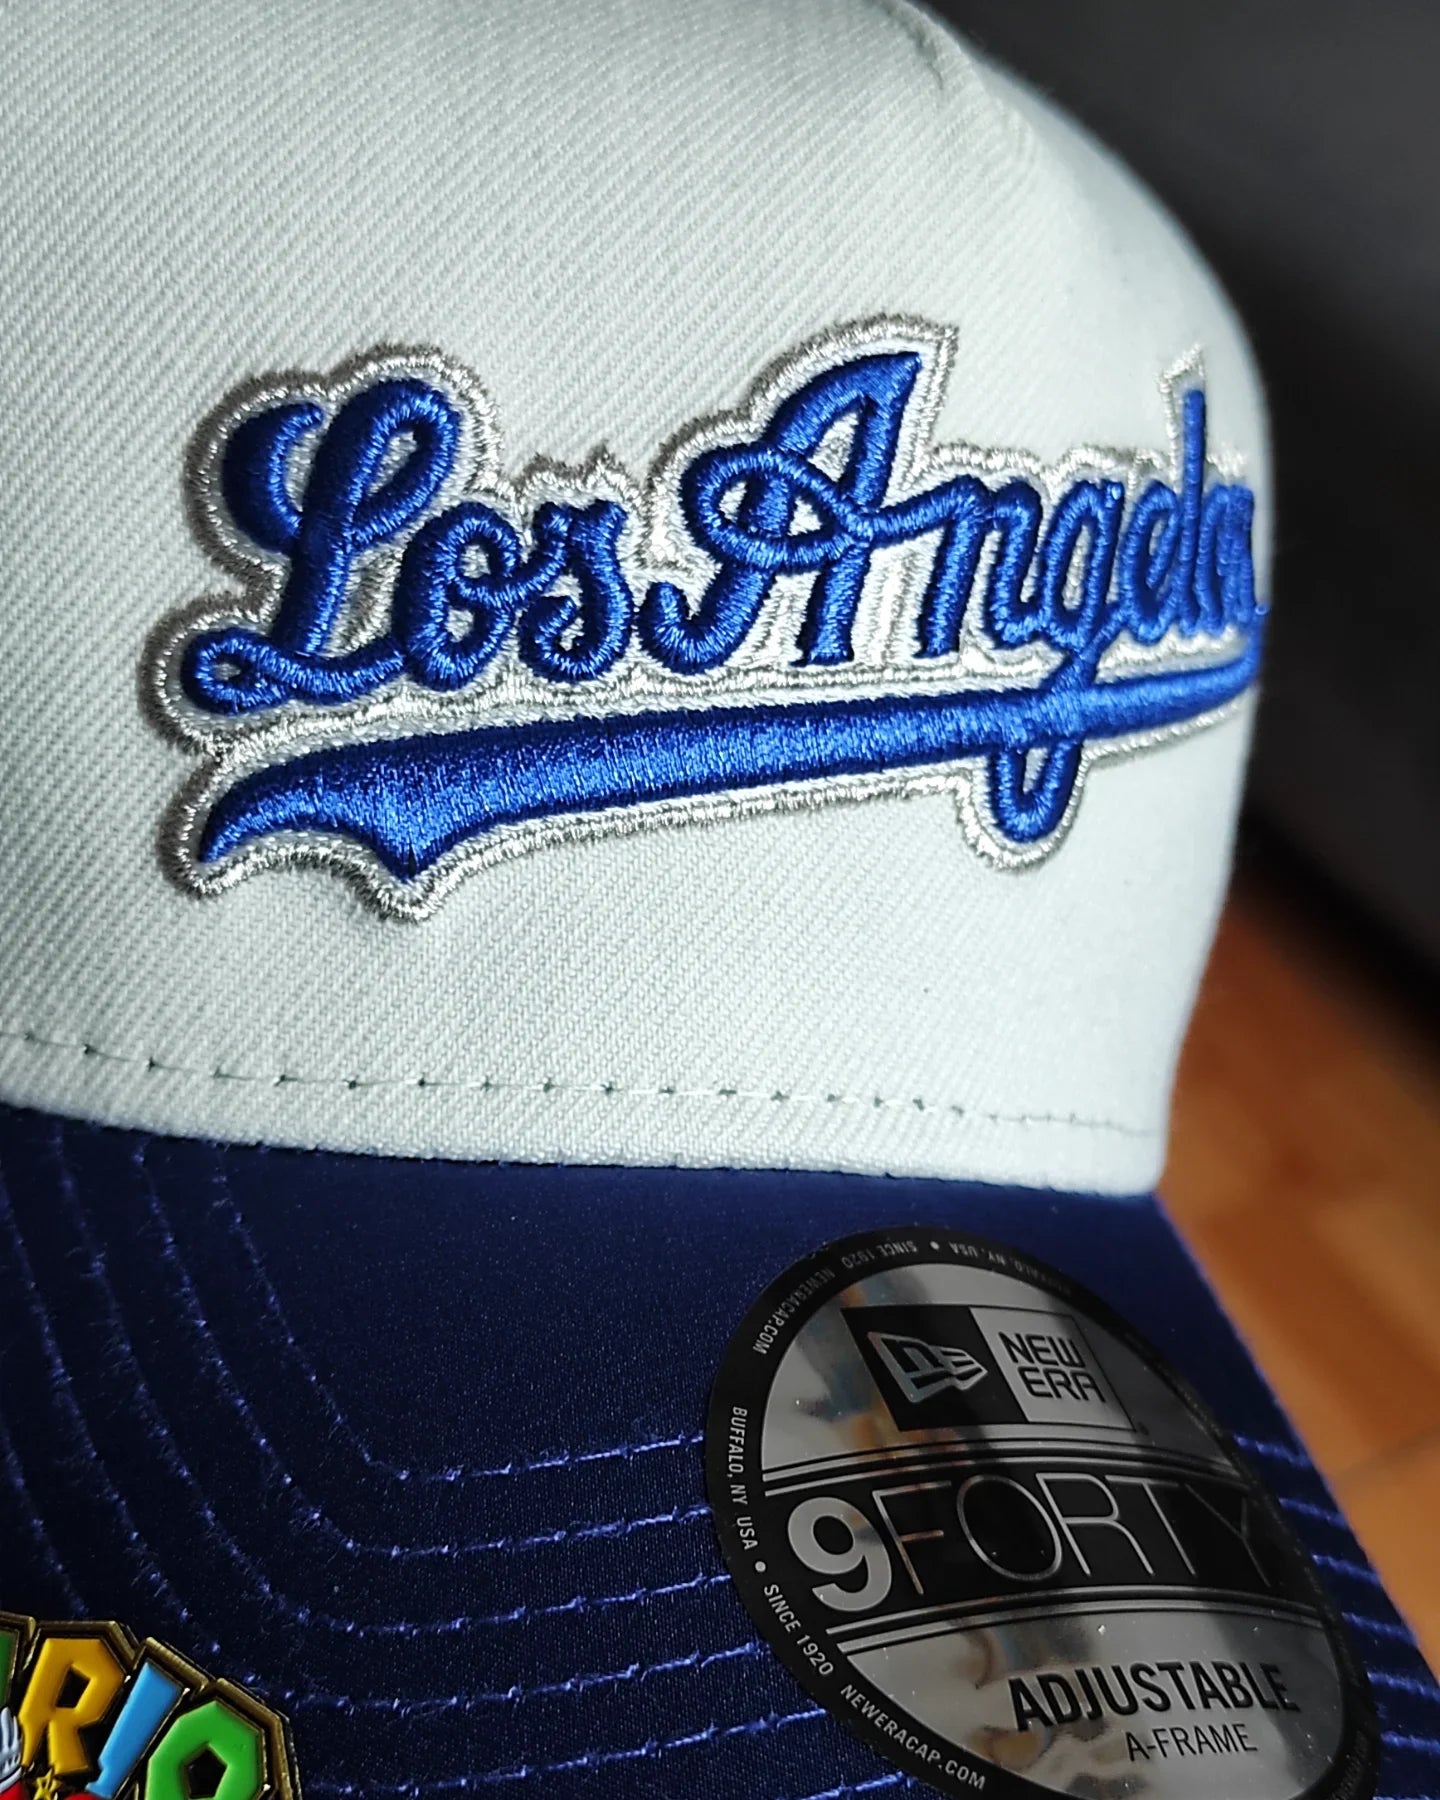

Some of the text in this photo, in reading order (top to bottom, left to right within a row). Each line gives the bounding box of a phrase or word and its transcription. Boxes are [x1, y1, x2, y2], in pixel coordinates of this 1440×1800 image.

[181, 377, 625, 691] Los
[841, 1251, 876, 1269] 1920
[875, 1240, 919, 1258] SINCE
[752, 1268, 836, 1355] NEWERACAP.COM
[998, 1331, 1086, 1369] NEW
[1017, 1365, 1107, 1403] ERA
[787, 1473, 1272, 1612] 9FORTY
[727, 1406, 986, 1790] BUFFALO, NY USA SINCE 1920 NEWERACAP.COM
[0, 1630, 264, 1800] RIO
[1008, 1661, 1301, 1731] ADJUSTABLE
[1125, 1723, 1257, 1761] A-FRAME
